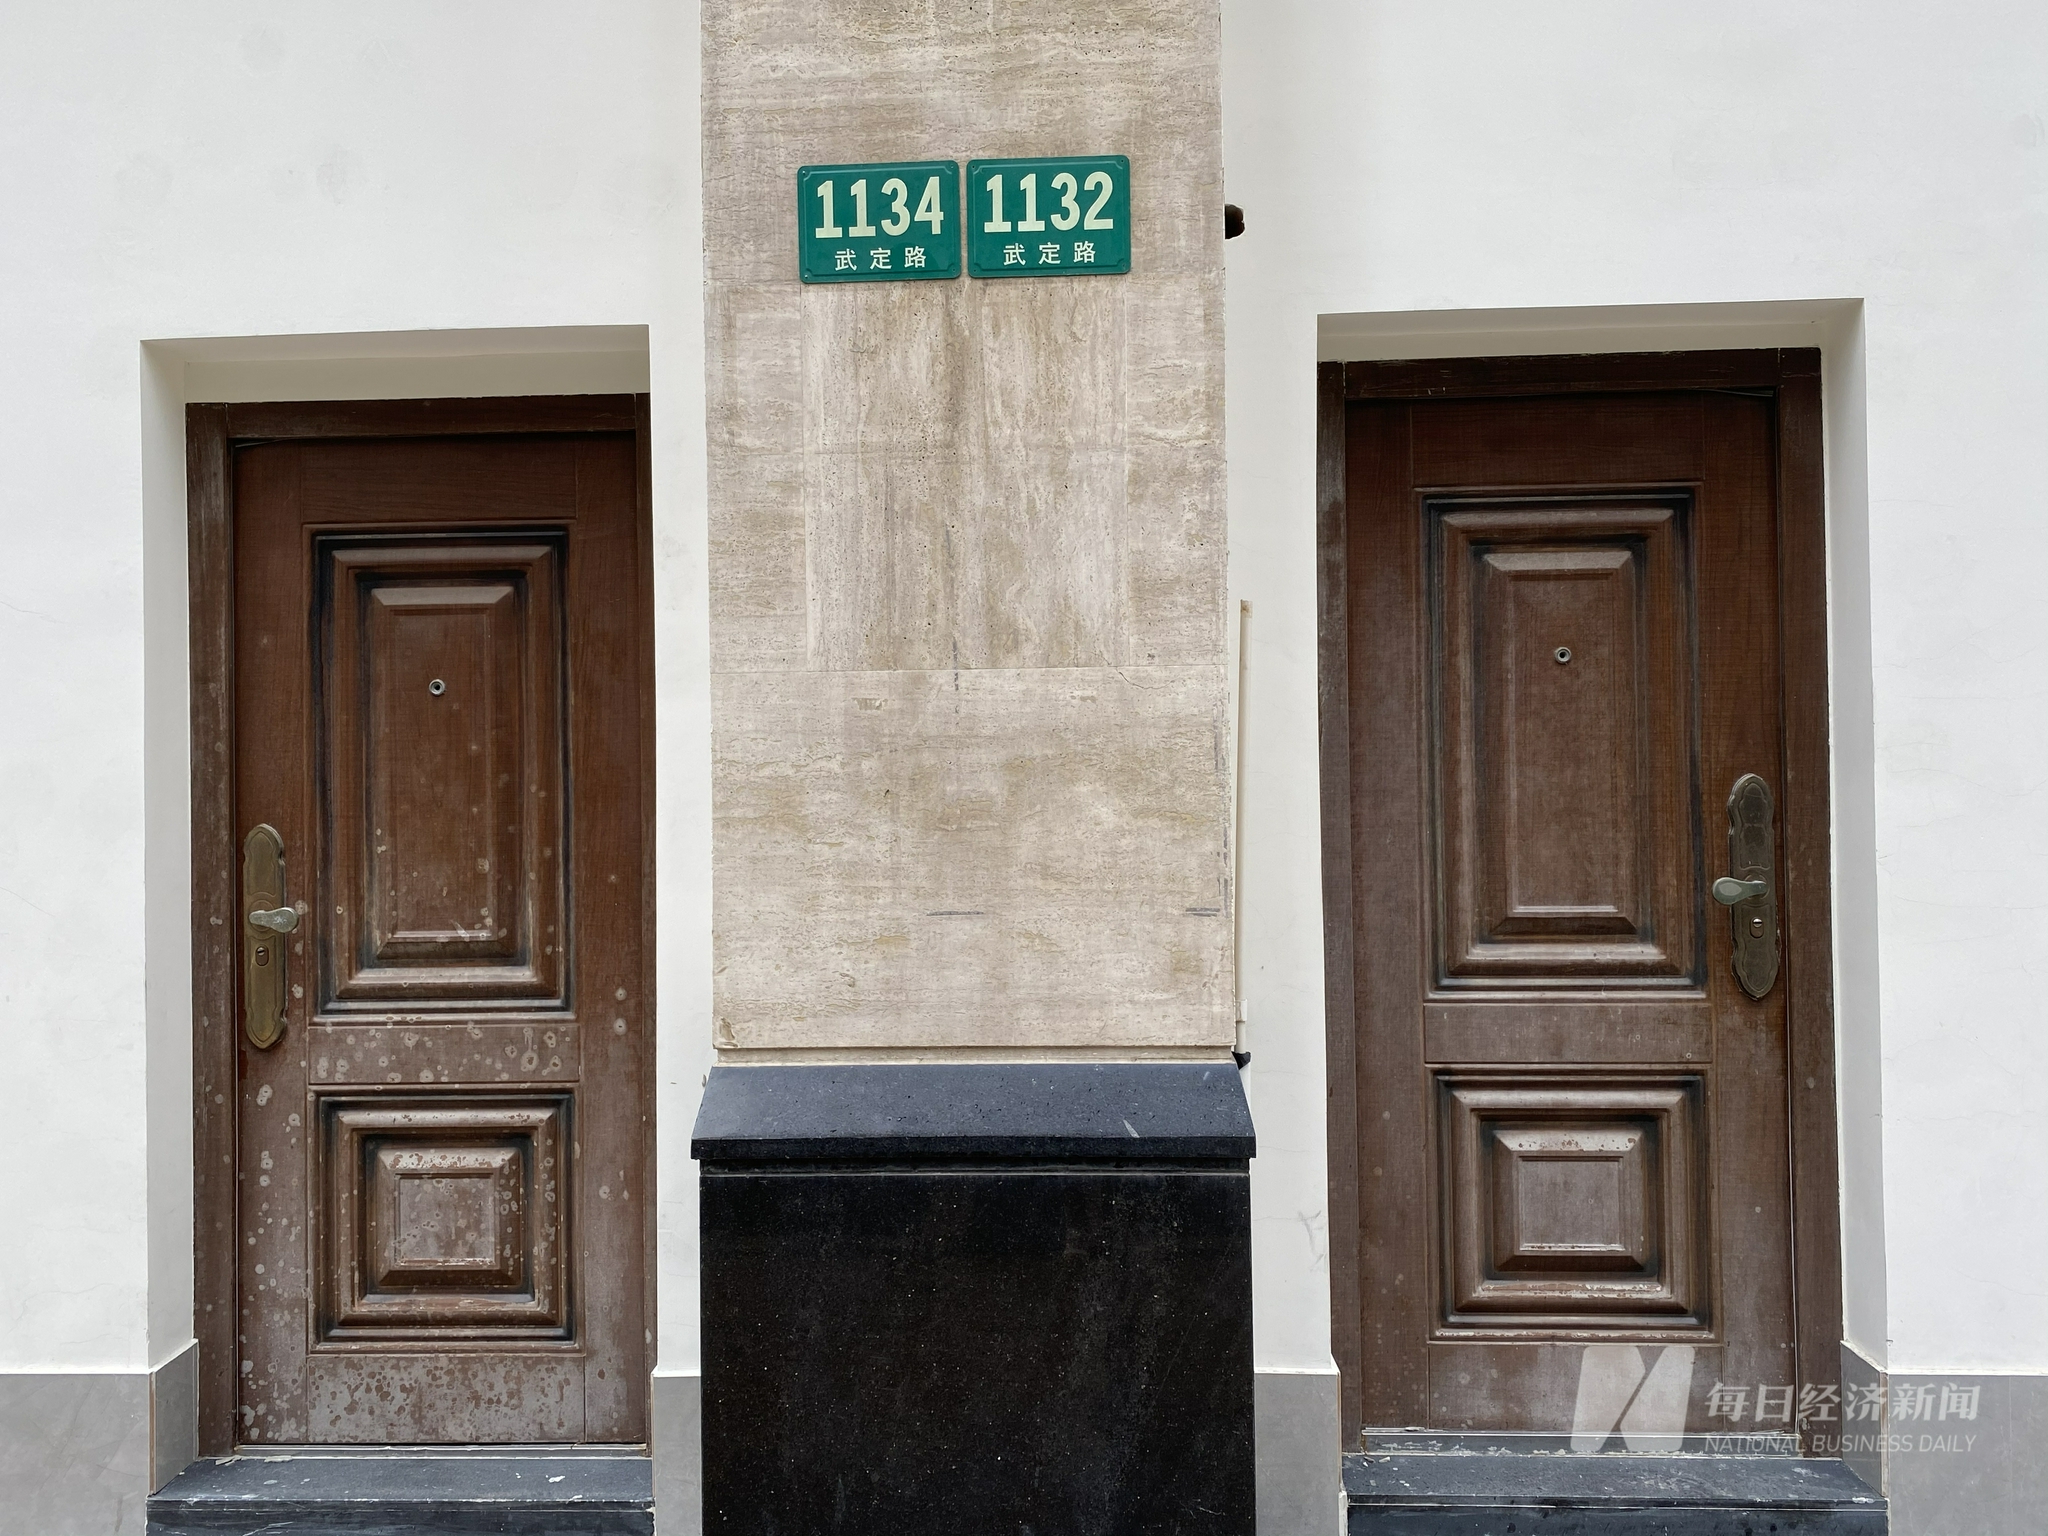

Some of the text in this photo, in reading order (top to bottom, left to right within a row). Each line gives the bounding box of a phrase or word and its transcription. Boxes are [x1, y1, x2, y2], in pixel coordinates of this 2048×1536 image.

[815, 176, 944, 239] 1134
[984, 171, 1114, 233] 1132
[834, 245, 927, 271] 武定路
[1003, 240, 1096, 266] 武定路
